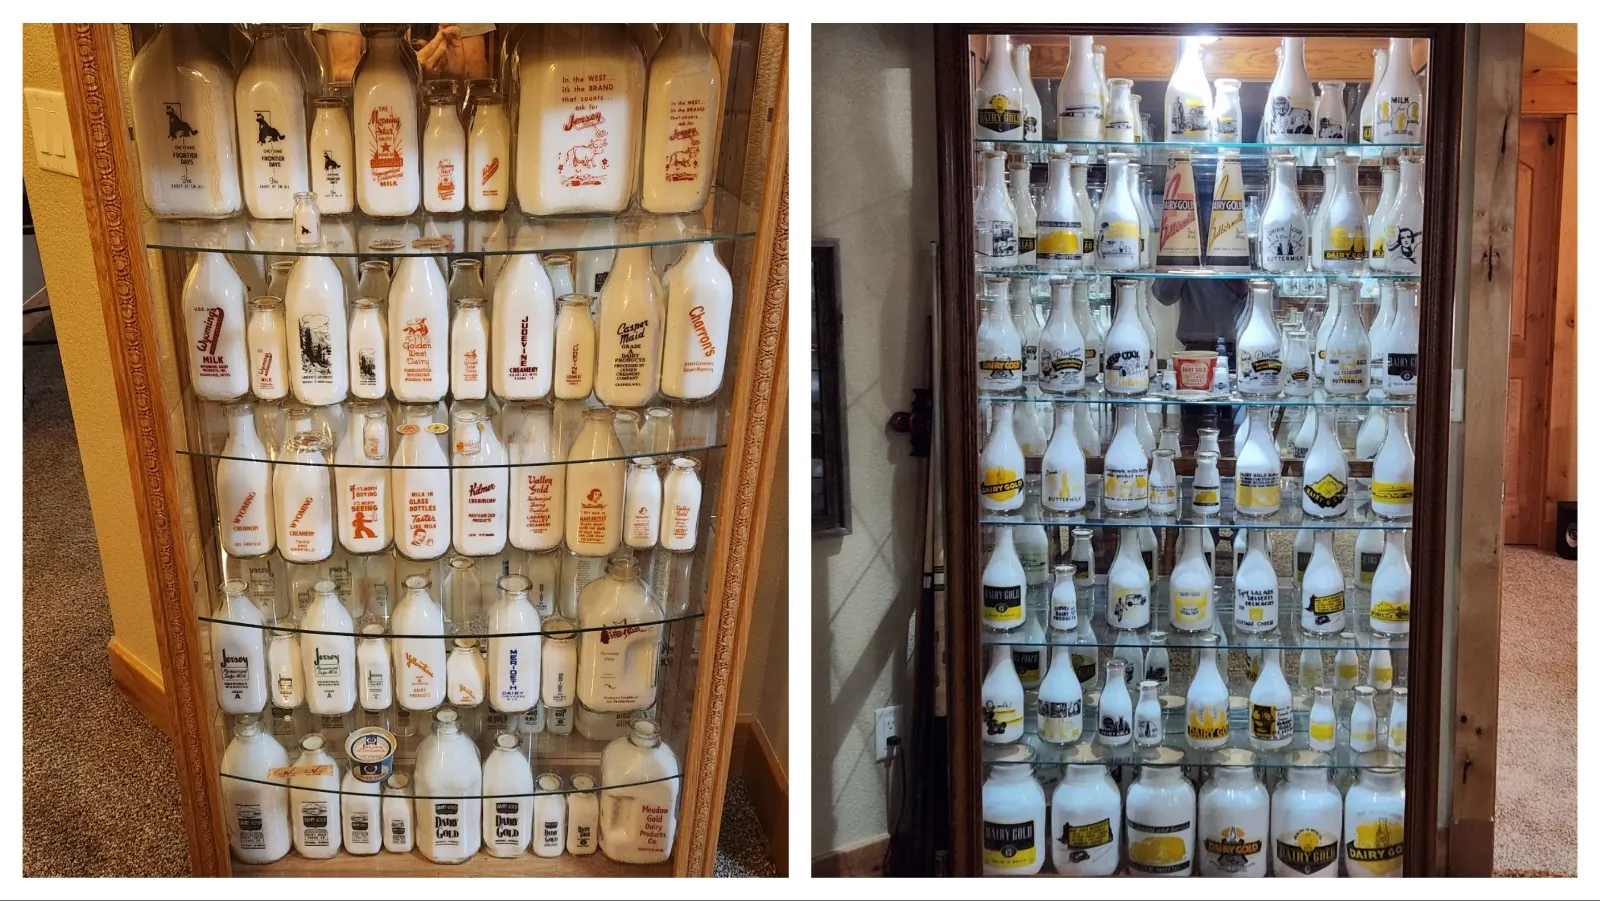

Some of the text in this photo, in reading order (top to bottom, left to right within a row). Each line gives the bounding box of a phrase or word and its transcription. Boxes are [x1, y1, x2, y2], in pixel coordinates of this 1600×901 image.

[1391, 96, 1409, 104] MILK
[368, 110, 401, 128] Morning
[562, 112, 602, 132] Jersey
[376, 126, 394, 135] Star
[1268, 226, 1284, 236] DRINK
[617, 320, 649, 335] Casper
[689, 305, 716, 357] Charron's
[520, 316, 528, 366] JUDEVINE
[620, 329, 646, 345] Maid
[403, 338, 431, 350] Golden
[407, 358, 429, 368] Dairy
[528, 475, 552, 485] Valley
[469, 482, 496, 497] Kilmer
[529, 485, 549, 495] Gold
[981, 480, 1023, 494] DAIRY GOLD
[1306, 488, 1323, 503] DAIRY
[234, 491, 256, 524] WYOMING
[289, 496, 313, 528] WYOMING
[412, 514, 436, 523] Tastes
[986, 589, 1002, 600] DAIRY
[220, 648, 248, 668] Jersey
[314, 648, 339, 665] Jersey
[510, 649, 518, 690] MERIDETH
[1189, 729, 1214, 740] DAIRY
[642, 805, 668, 814] Meadow
[435, 816, 458, 828] DAIRY
[496, 815, 519, 827] DAIRY
[437, 828, 459, 839] GOLD
[497, 827, 519, 838] GOLD
[986, 825, 1032, 841] DAIRY GOLD
[1209, 842, 1258, 854] DAIRY GOLD
[1350, 848, 1384, 859] DAIRY
[1280, 847, 1335, 862] DAIRY GOLD
